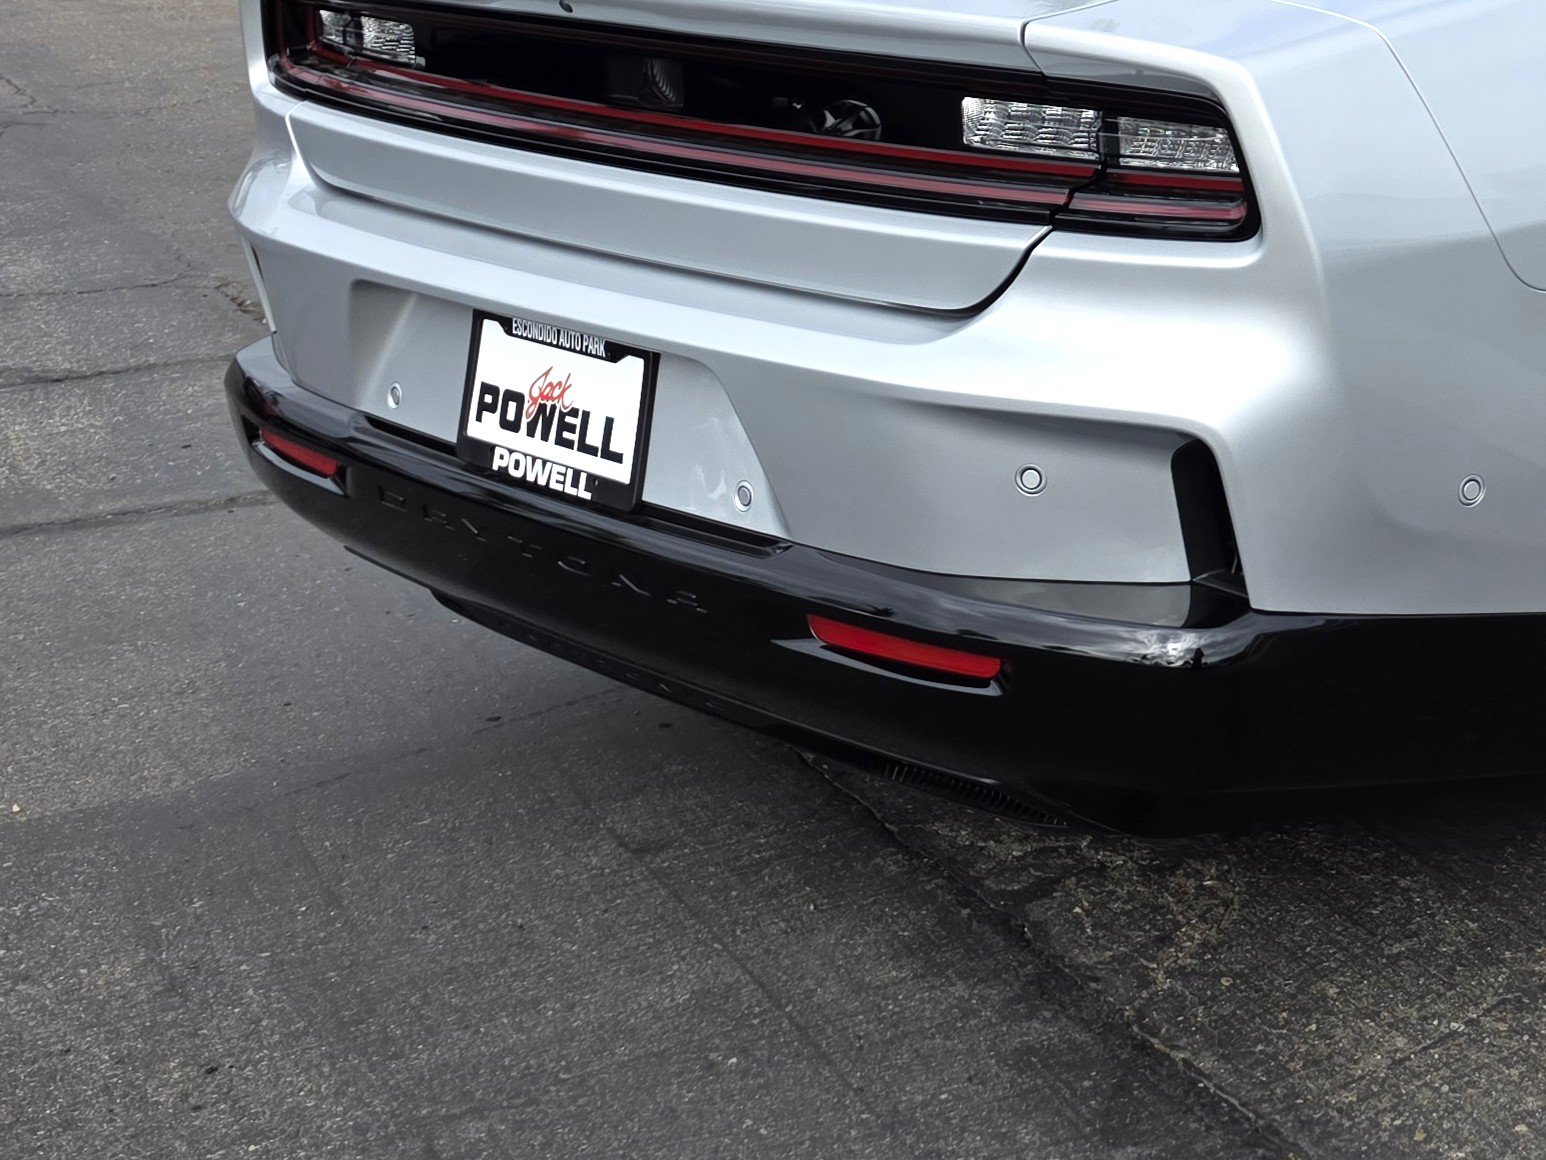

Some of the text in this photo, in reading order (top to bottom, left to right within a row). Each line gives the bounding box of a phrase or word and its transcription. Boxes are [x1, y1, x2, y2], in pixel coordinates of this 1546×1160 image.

[511, 317, 606, 358] ESCONDIDO AUTO PARK
[525, 366, 574, 420] Jack
[475, 381, 624, 465] POWELL
[491, 446, 593, 501] POWELL
